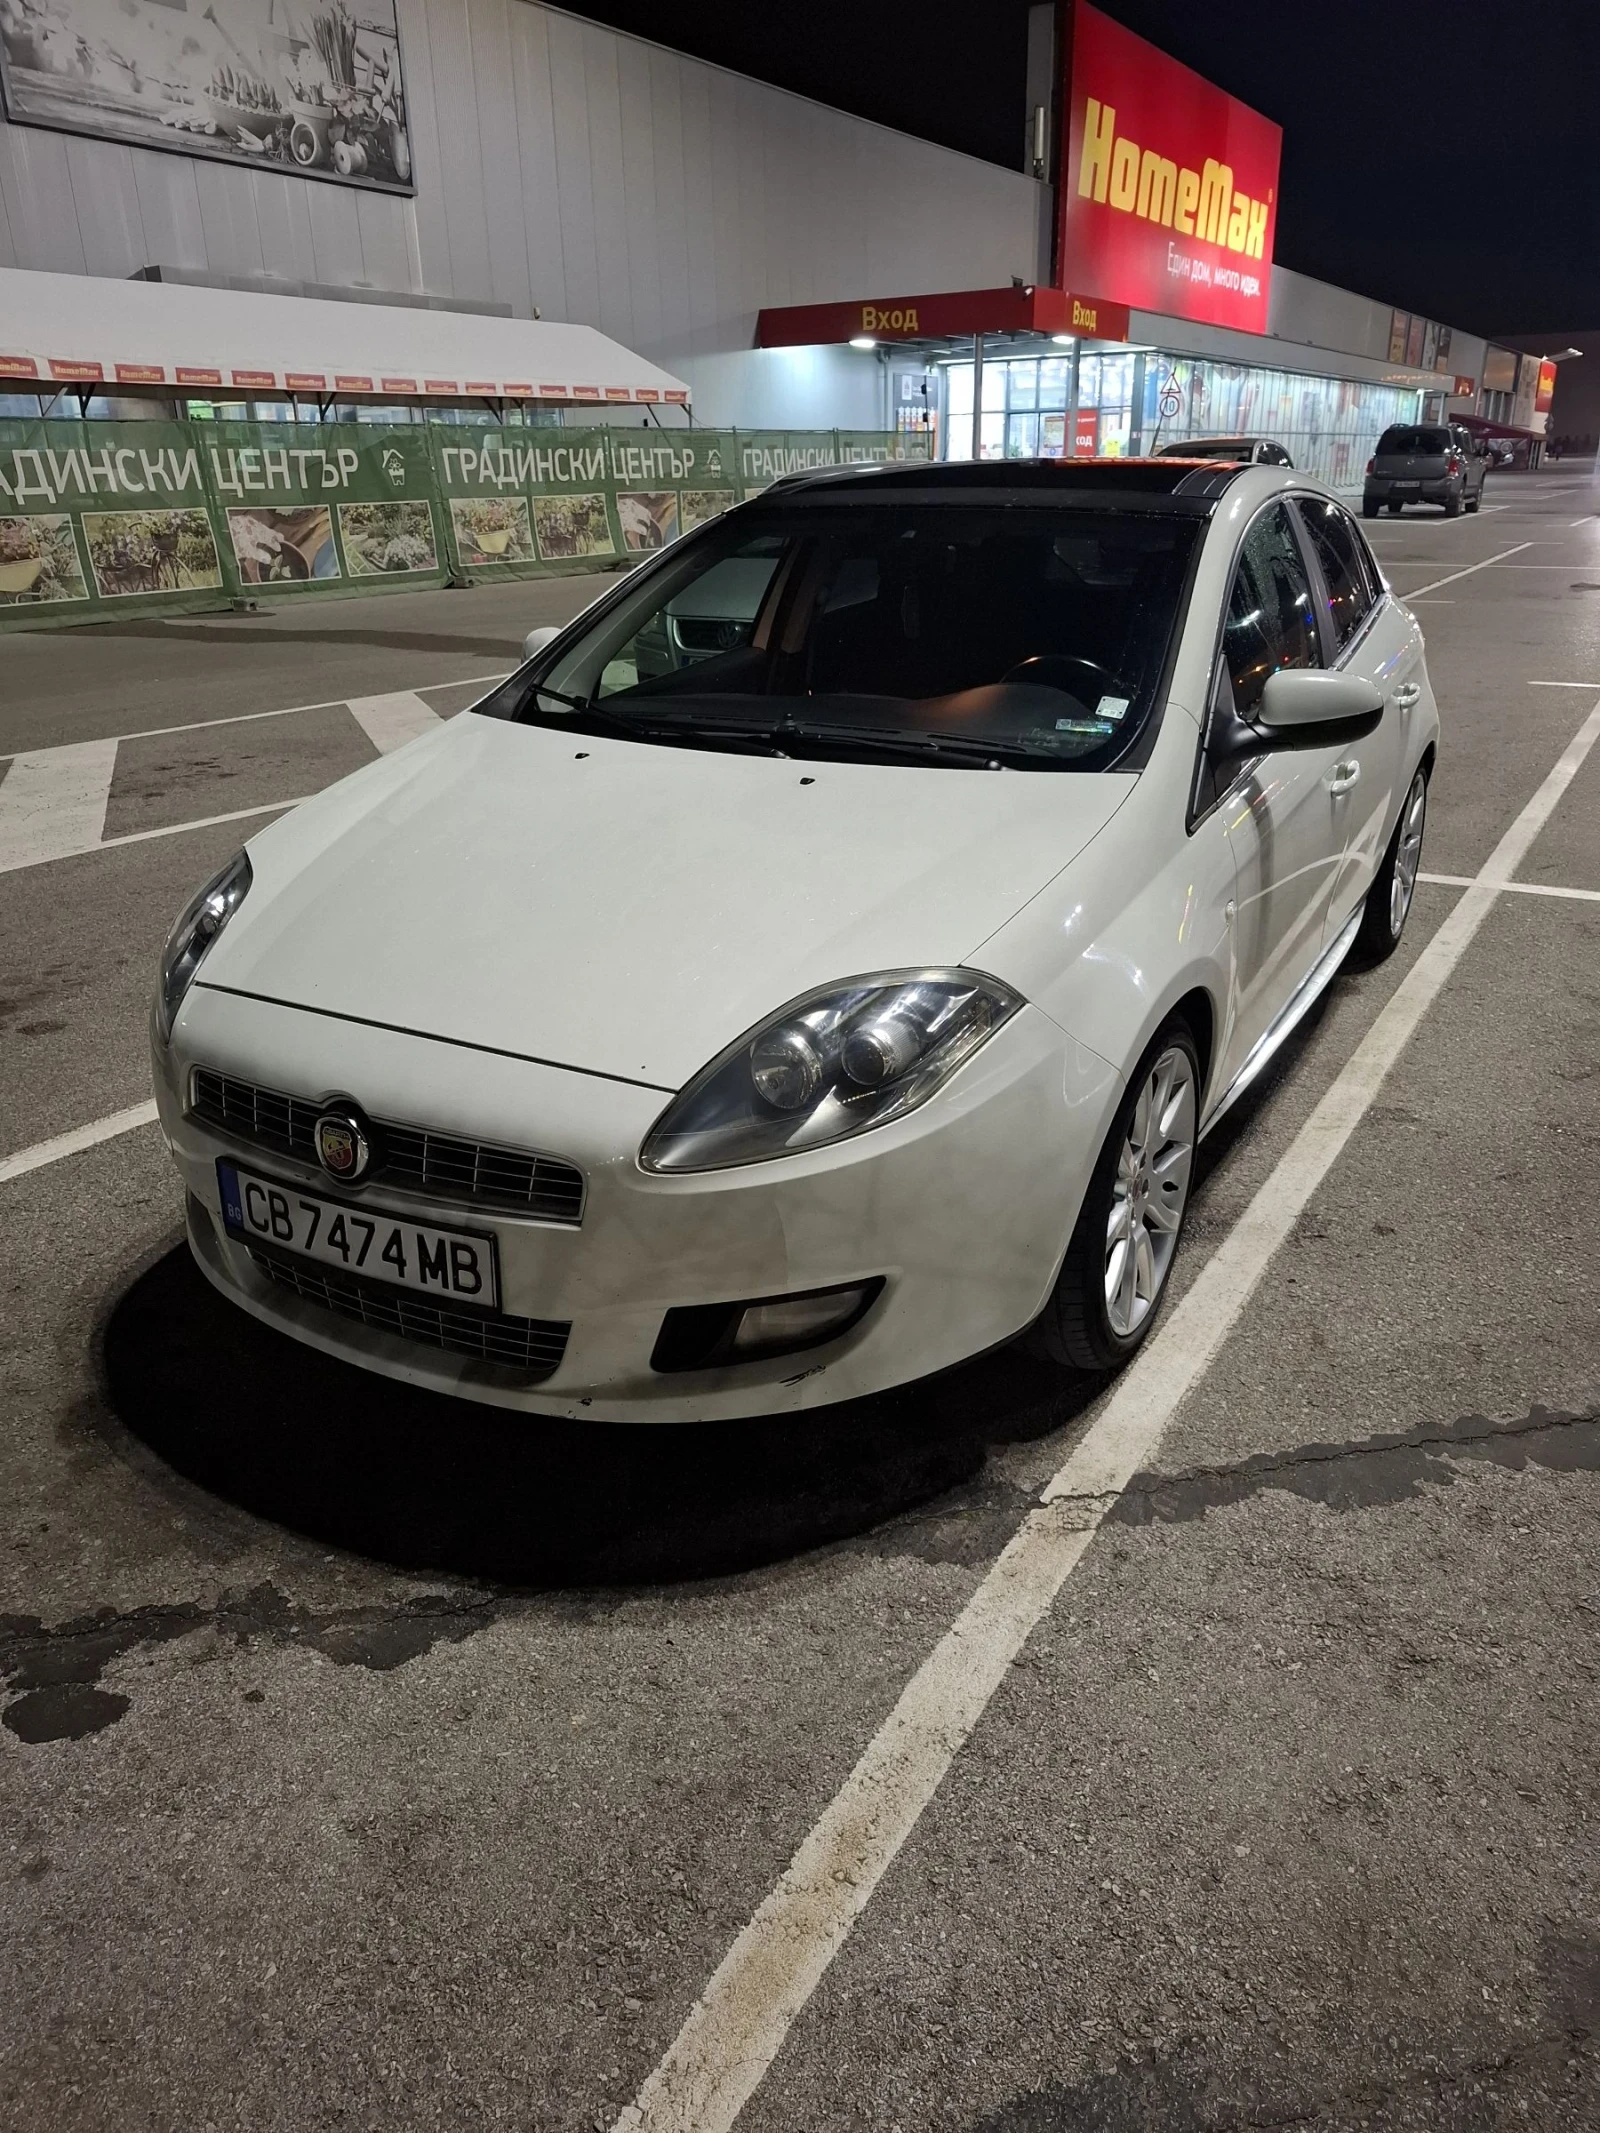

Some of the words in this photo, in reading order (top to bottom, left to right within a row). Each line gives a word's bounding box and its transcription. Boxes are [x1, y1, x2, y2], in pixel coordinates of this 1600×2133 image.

[1078, 97, 1268, 260] HomeMax
[1167, 241, 1191, 278] Един
[1213, 266, 1240, 291] много
[862, 306, 919, 332] Вход
[1072, 300, 1097, 332] Вход
[210, 448, 359, 498] ЦЕНТЪР
[442, 448, 606, 490] ГРАДИНСКИ
[611, 448, 695, 486] ЦЕНТЪР
[227, 1203, 242, 1221] BG
